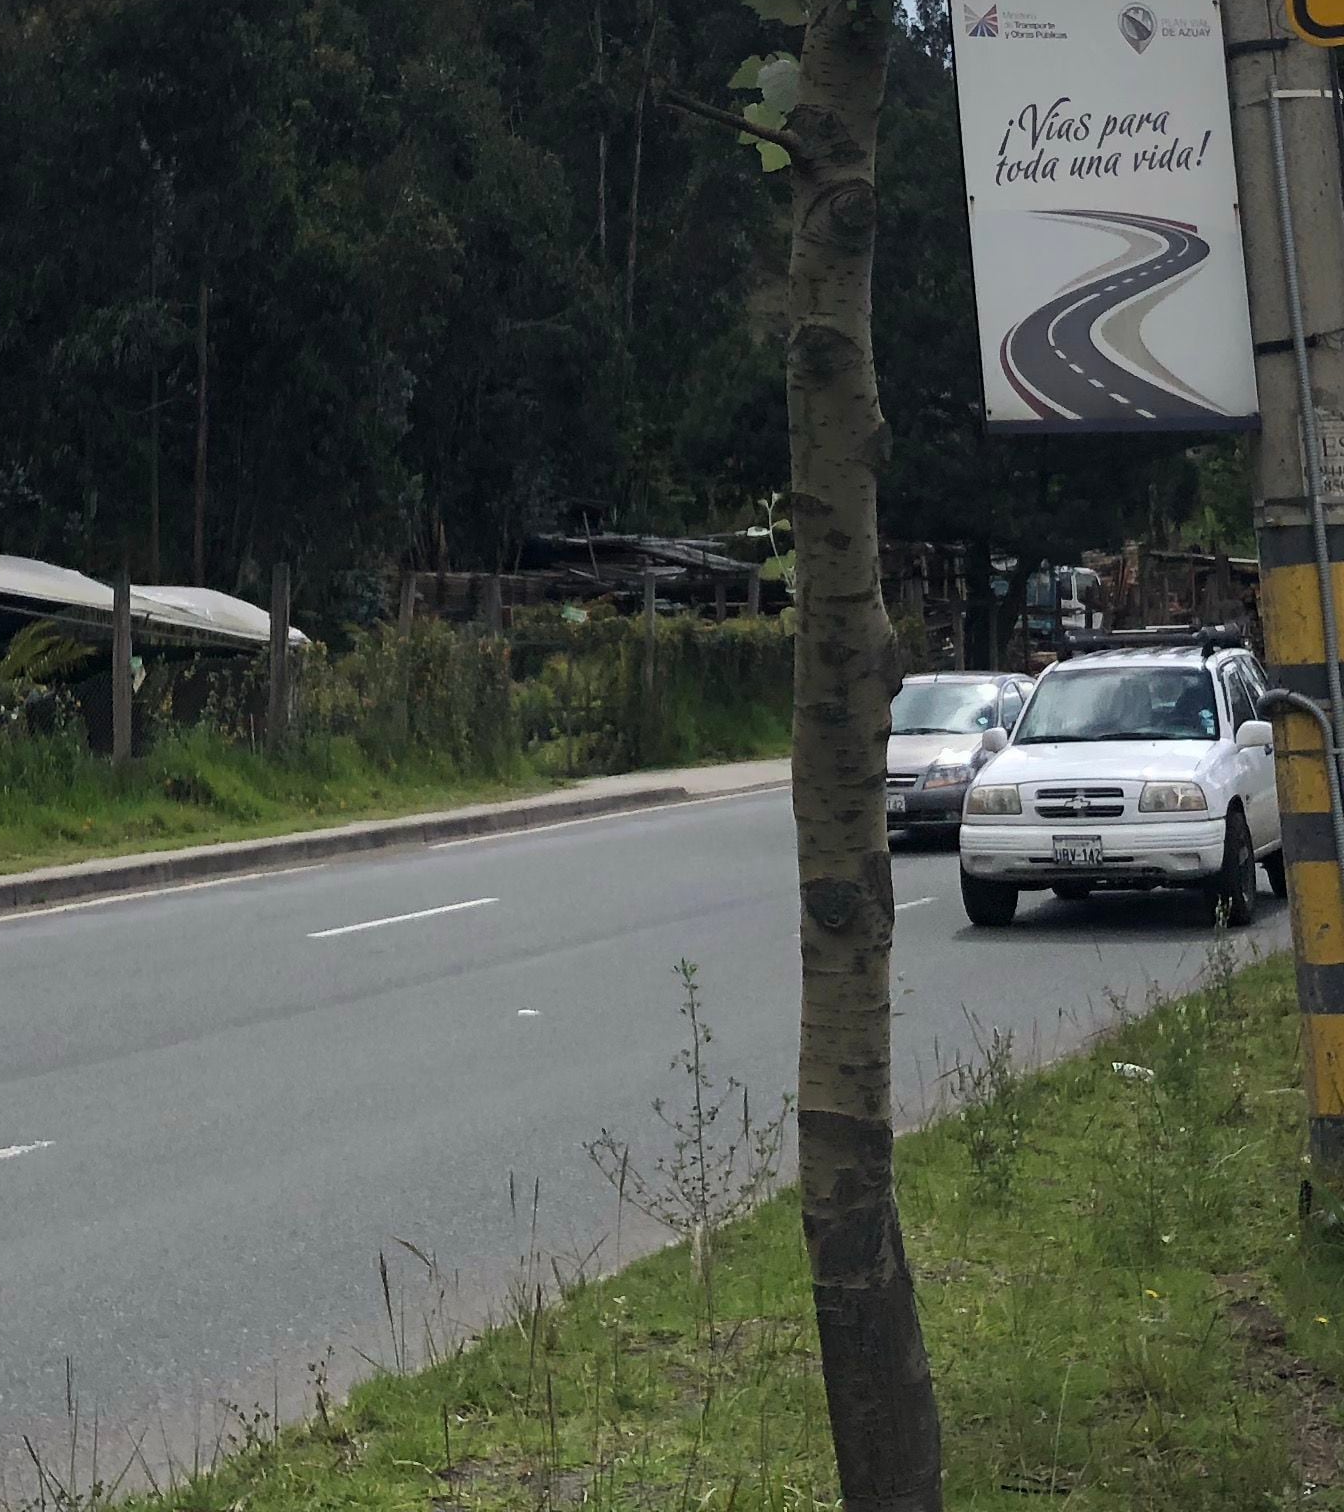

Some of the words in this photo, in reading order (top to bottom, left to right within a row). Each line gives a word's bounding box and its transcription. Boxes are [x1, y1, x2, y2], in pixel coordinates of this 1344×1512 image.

[1161, 28, 1176, 37] DE
[1178, 27, 1211, 37] AZUAY
[1097, 110, 1171, 150] para
[995, 147, 1060, 186] toda
[1069, 152, 1122, 180] una
[1133, 130, 1212, 173] vida!
